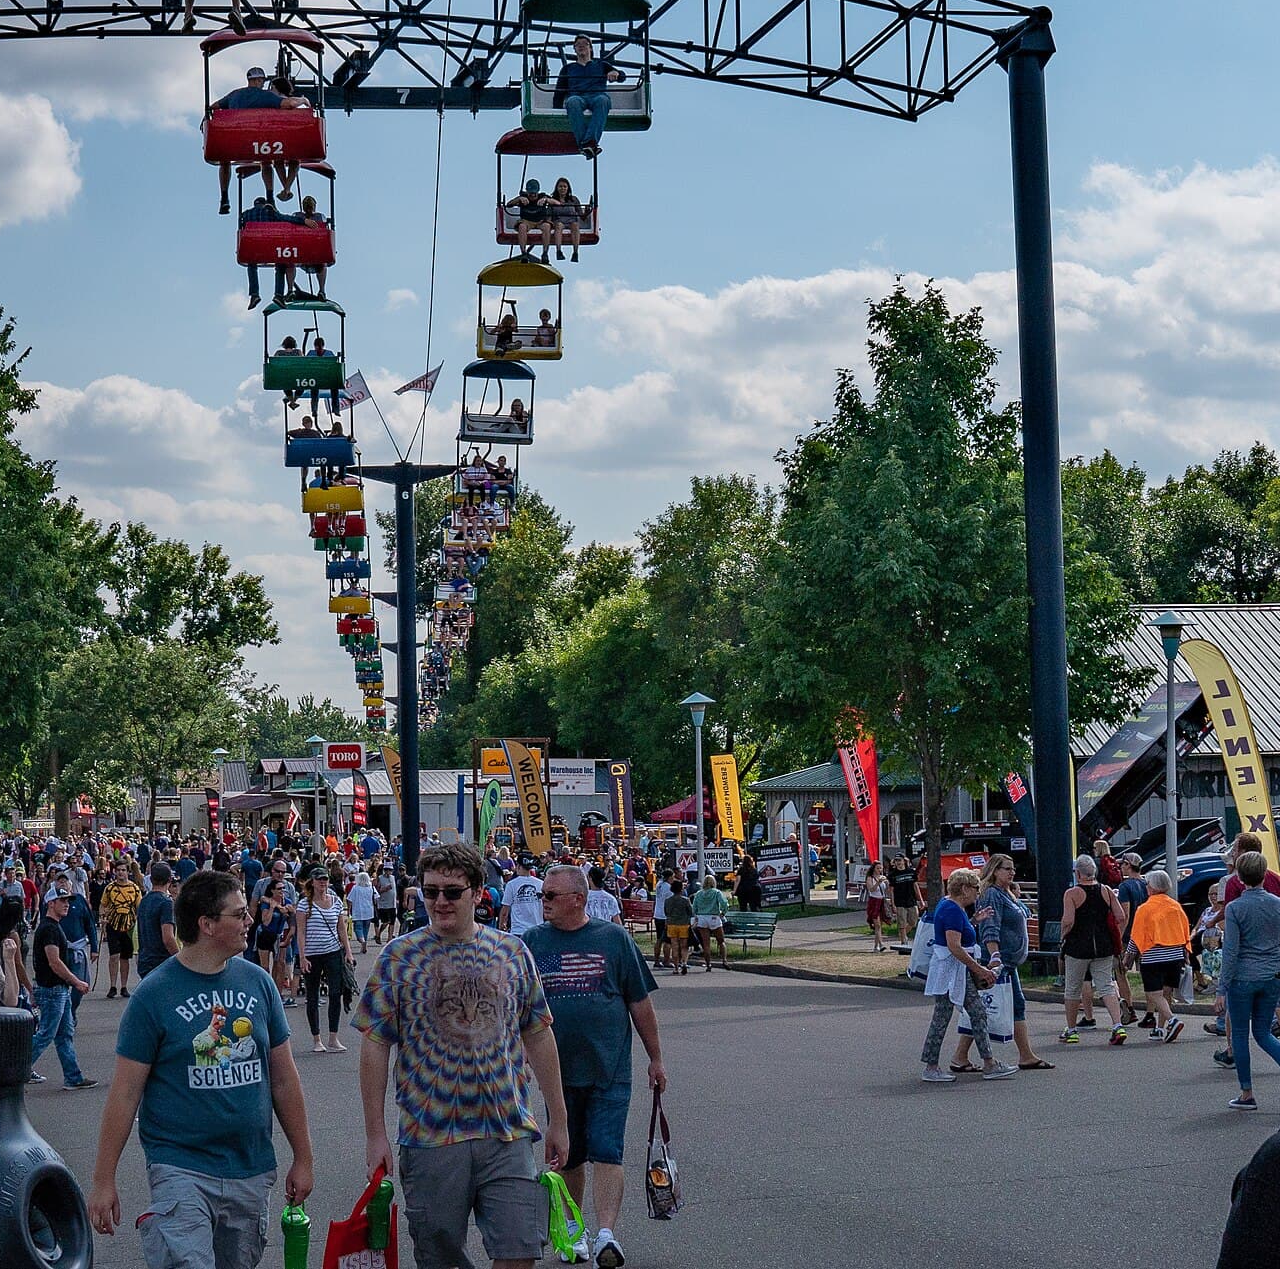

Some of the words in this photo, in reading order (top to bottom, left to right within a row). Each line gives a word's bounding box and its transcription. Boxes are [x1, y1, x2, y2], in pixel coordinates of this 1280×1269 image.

[397, 89, 411, 105] 7
[252, 141, 284, 155] 162
[275, 247, 298, 258] 161
[295, 379, 317, 387] 160
[310, 457, 328, 465] 159
[401, 491, 410, 500] 6
[329, 752, 359, 762] TORO
[487, 758, 506, 767] Cub
[550, 766, 583, 774] Warehouse
[584, 766, 595, 774] Inc.
[518, 757, 544, 837] WELCOME
[704, 859, 732, 869] LDINGS
[175, 989, 258, 1023] BECAUSE
[192, 1061, 260, 1087] SCIENCE
